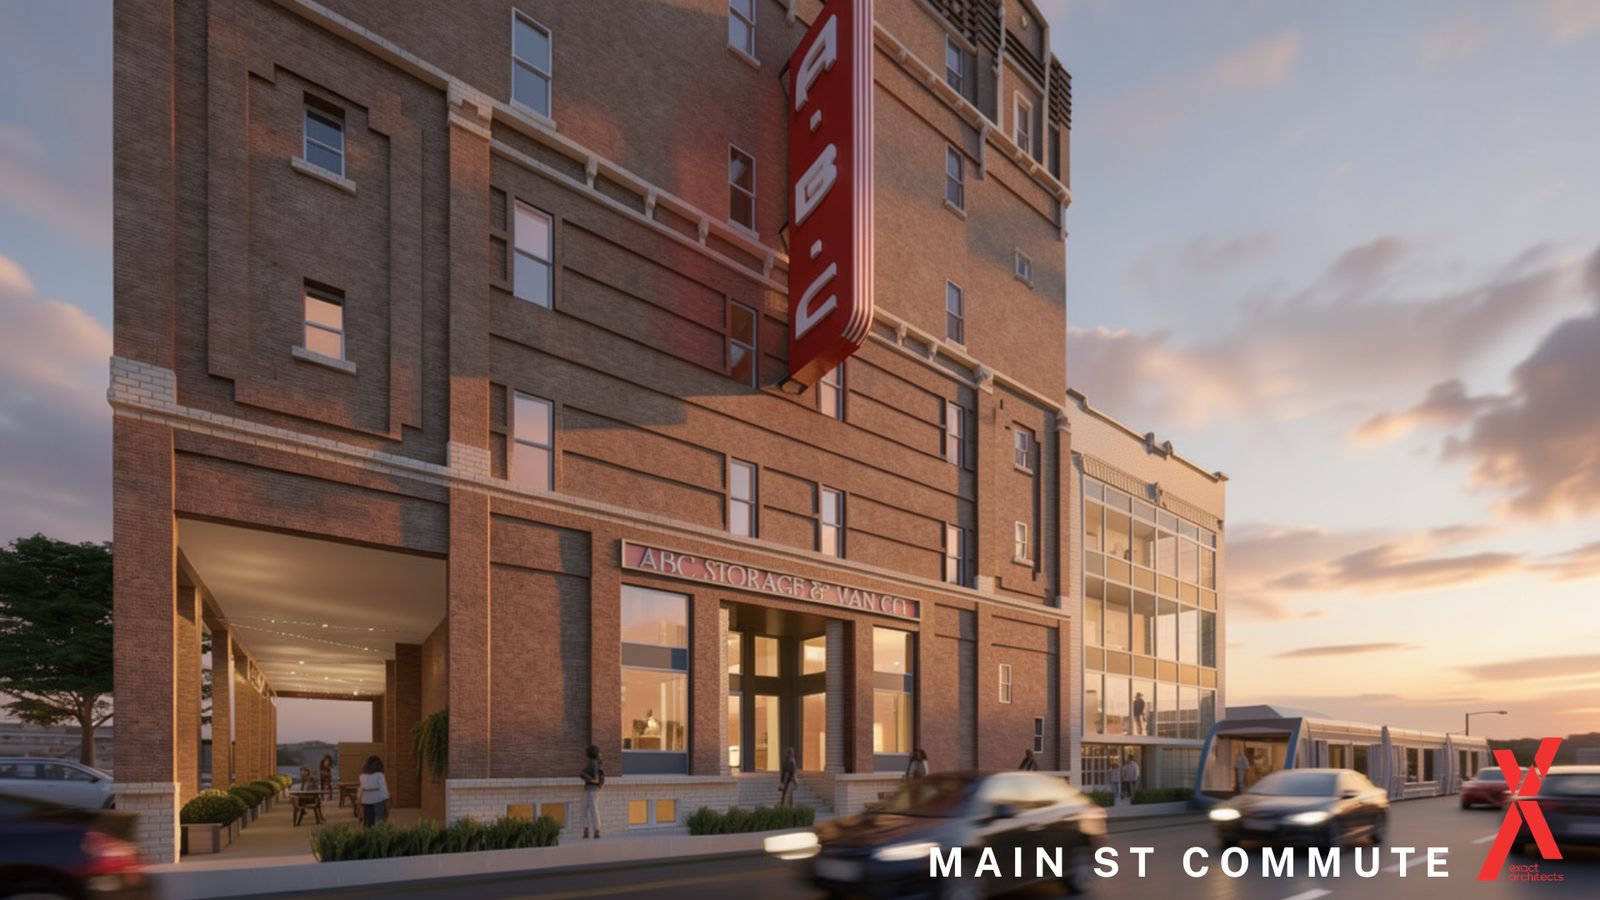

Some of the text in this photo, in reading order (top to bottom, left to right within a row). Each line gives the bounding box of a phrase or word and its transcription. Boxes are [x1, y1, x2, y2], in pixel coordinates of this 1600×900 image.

[639, 548, 695, 578] ABC
[810, 581, 830, 600] &
[837, 586, 875, 611] VAN
